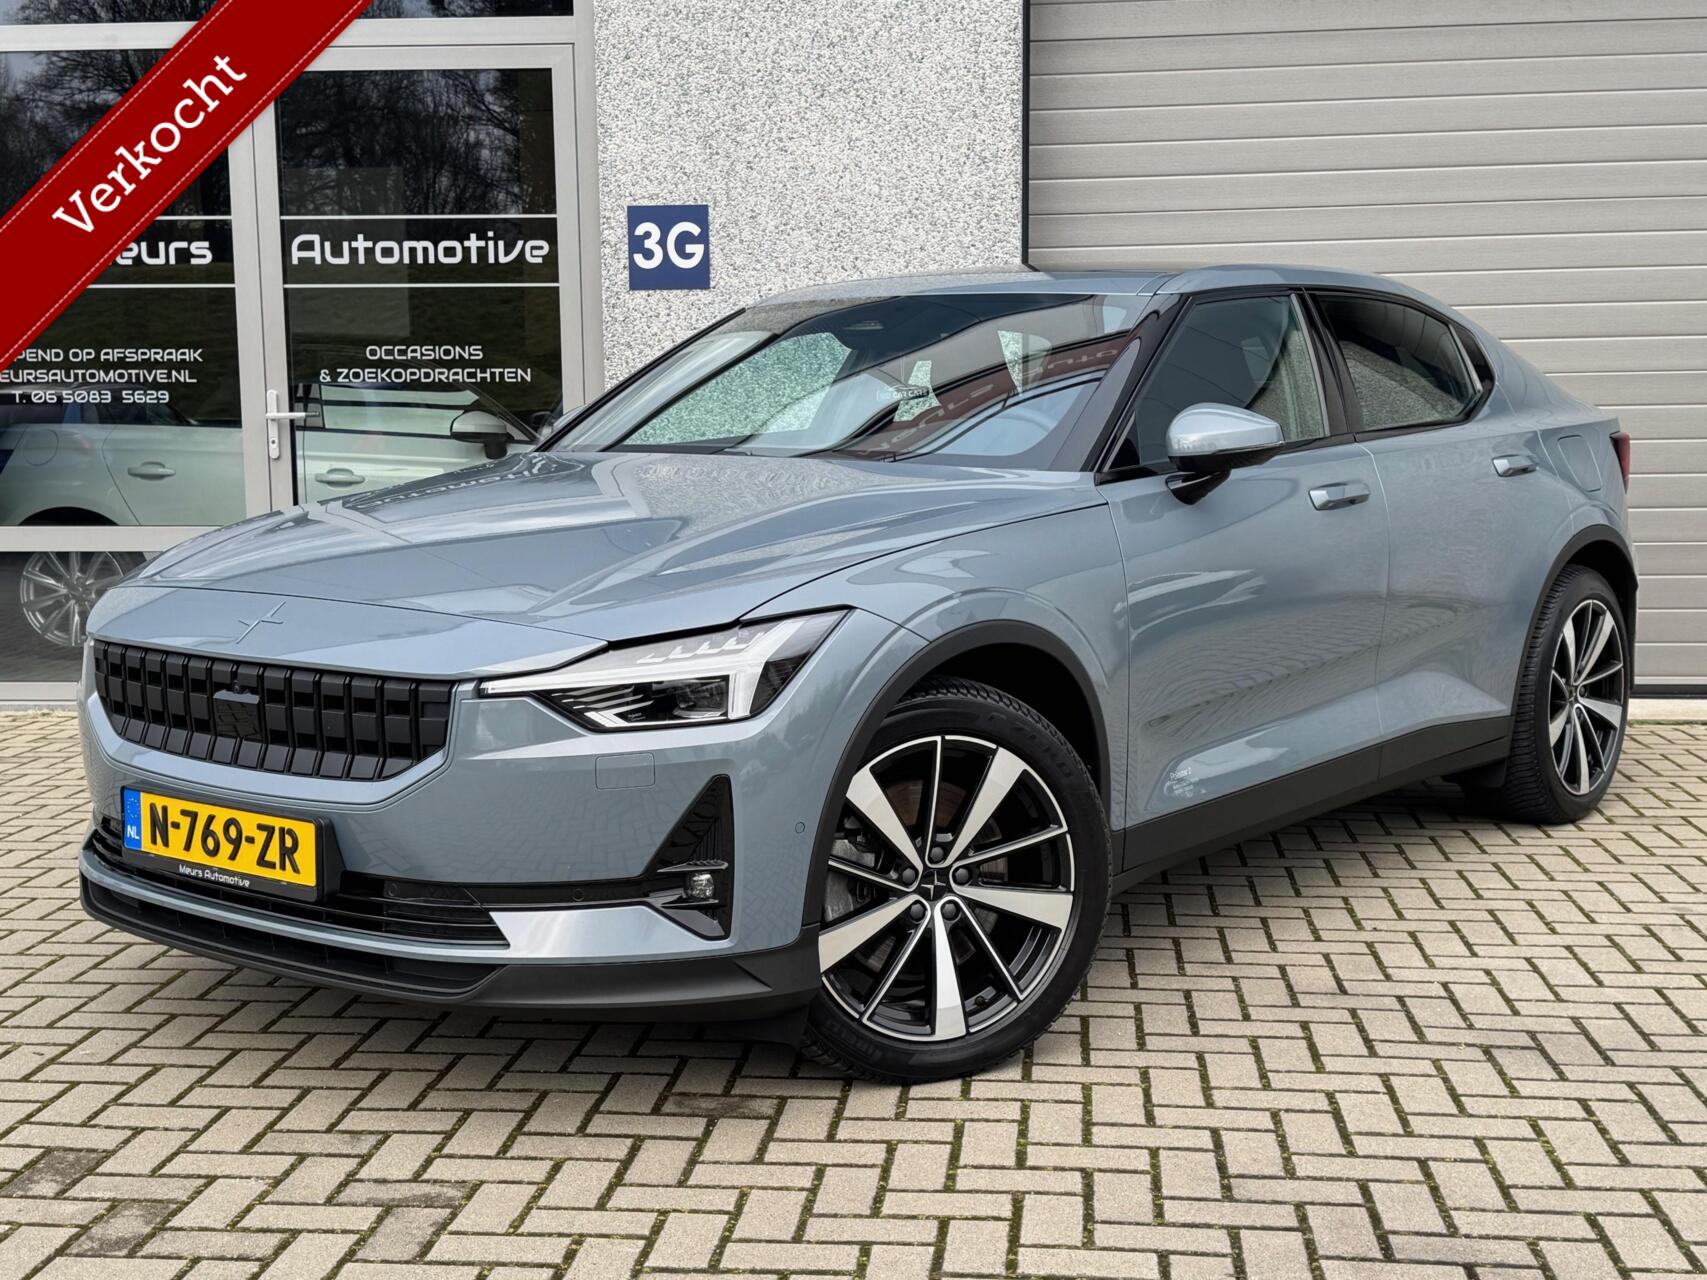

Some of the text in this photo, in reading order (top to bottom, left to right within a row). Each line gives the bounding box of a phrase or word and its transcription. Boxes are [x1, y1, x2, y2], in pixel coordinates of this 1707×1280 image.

[109, 231, 550, 265] eurs Automotive
[633, 221, 705, 269] 3G
[69, 348, 95, 362] OP
[100, 348, 203, 362] AFSPRAAK
[366, 345, 483, 360] OCCASIONS
[319, 367, 531, 383] & ZOEKOPDRACHTEN
[11, 390, 169, 403] T. 06 5083 5629
[127, 825, 140, 839] NL
[150, 802, 301, 875] N-769-ZR
[178, 863, 250, 888] Meurs Automotive
